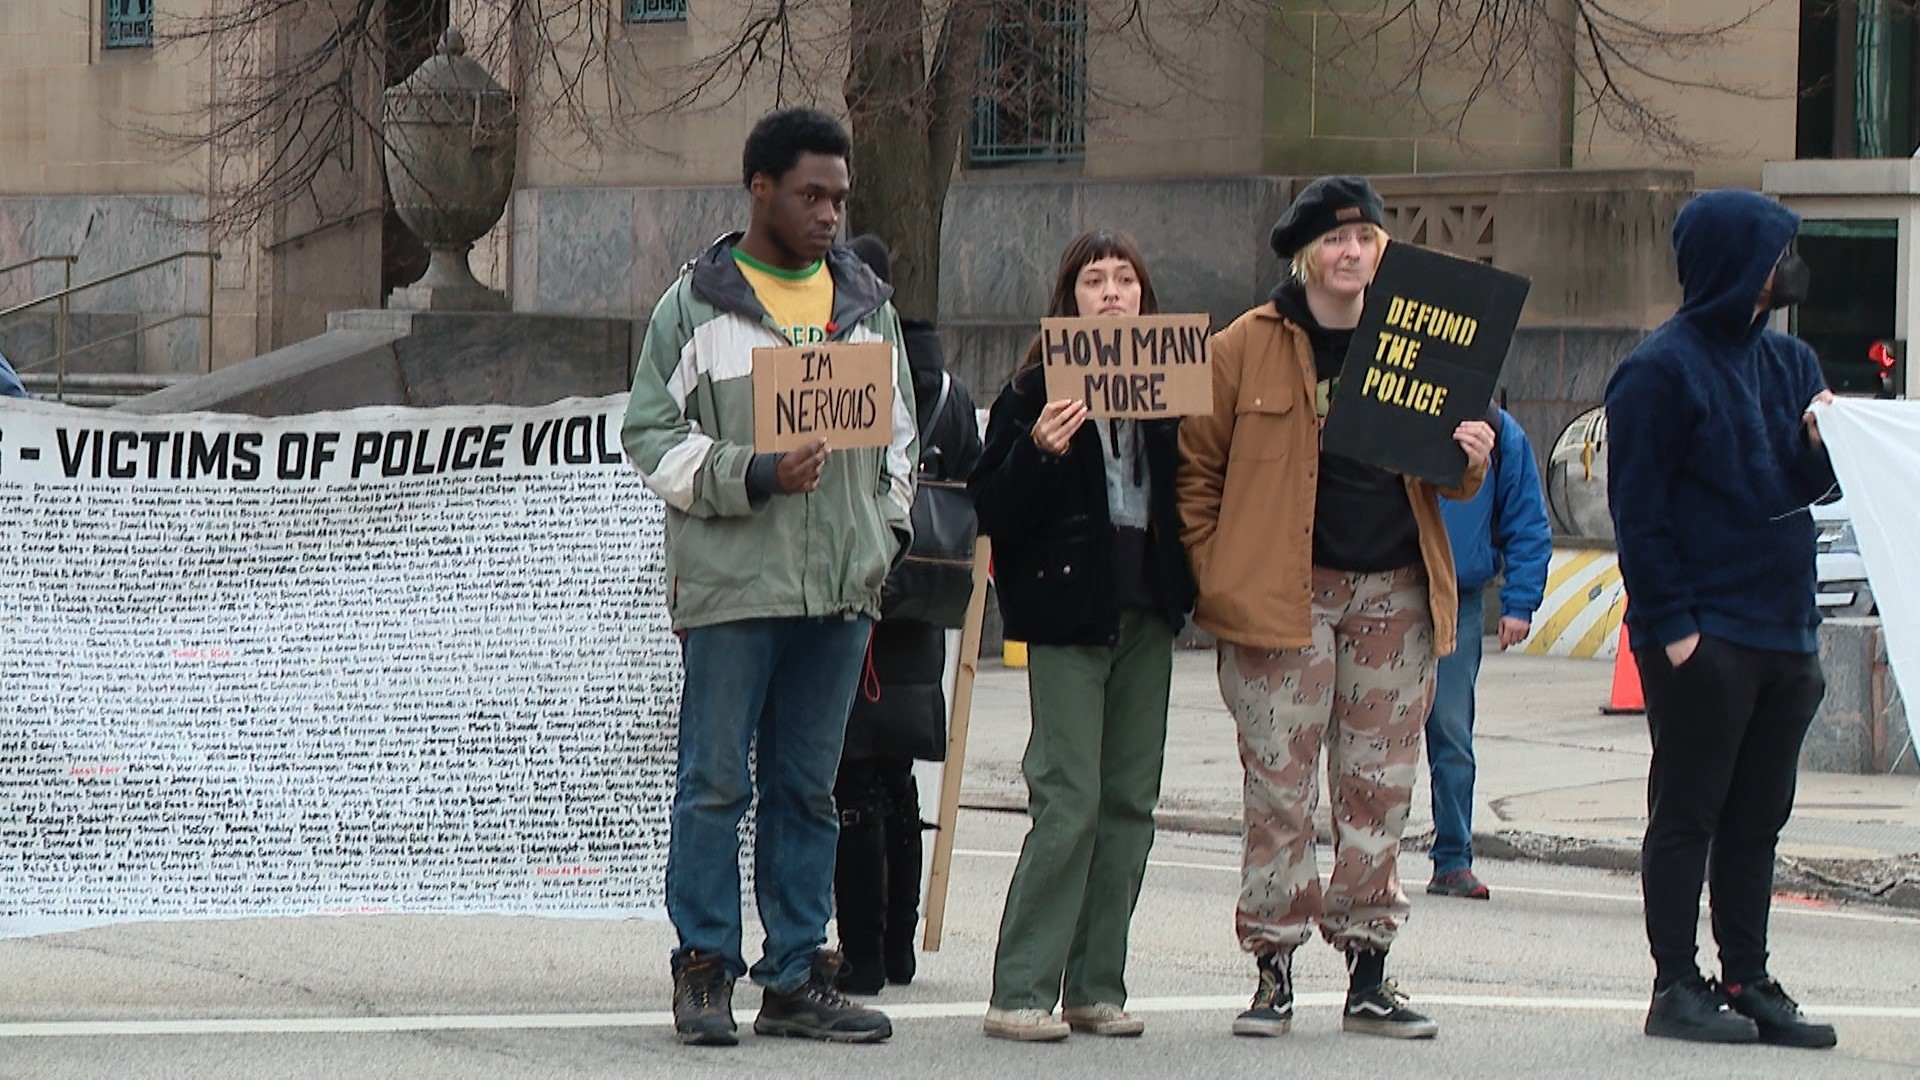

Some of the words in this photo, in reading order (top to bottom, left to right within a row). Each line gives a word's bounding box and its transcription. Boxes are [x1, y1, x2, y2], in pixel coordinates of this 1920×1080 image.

[1385, 295, 1479, 347] DEFUND
[801, 351, 833, 382] IM
[1045, 328, 1121, 366] HOW
[1131, 325, 1211, 366] MANY
[1375, 331, 1422, 371] THE
[776, 383, 876, 435] NERVOUS
[1084, 372, 1166, 412] MORE
[1361, 366, 1448, 416] POLICE
[56, 427, 264, 480] VICTIMS
[276, 431, 341, 480] OF
[350, 423, 513, 478] POLICE
[522, 414, 629, 465] VIOL
